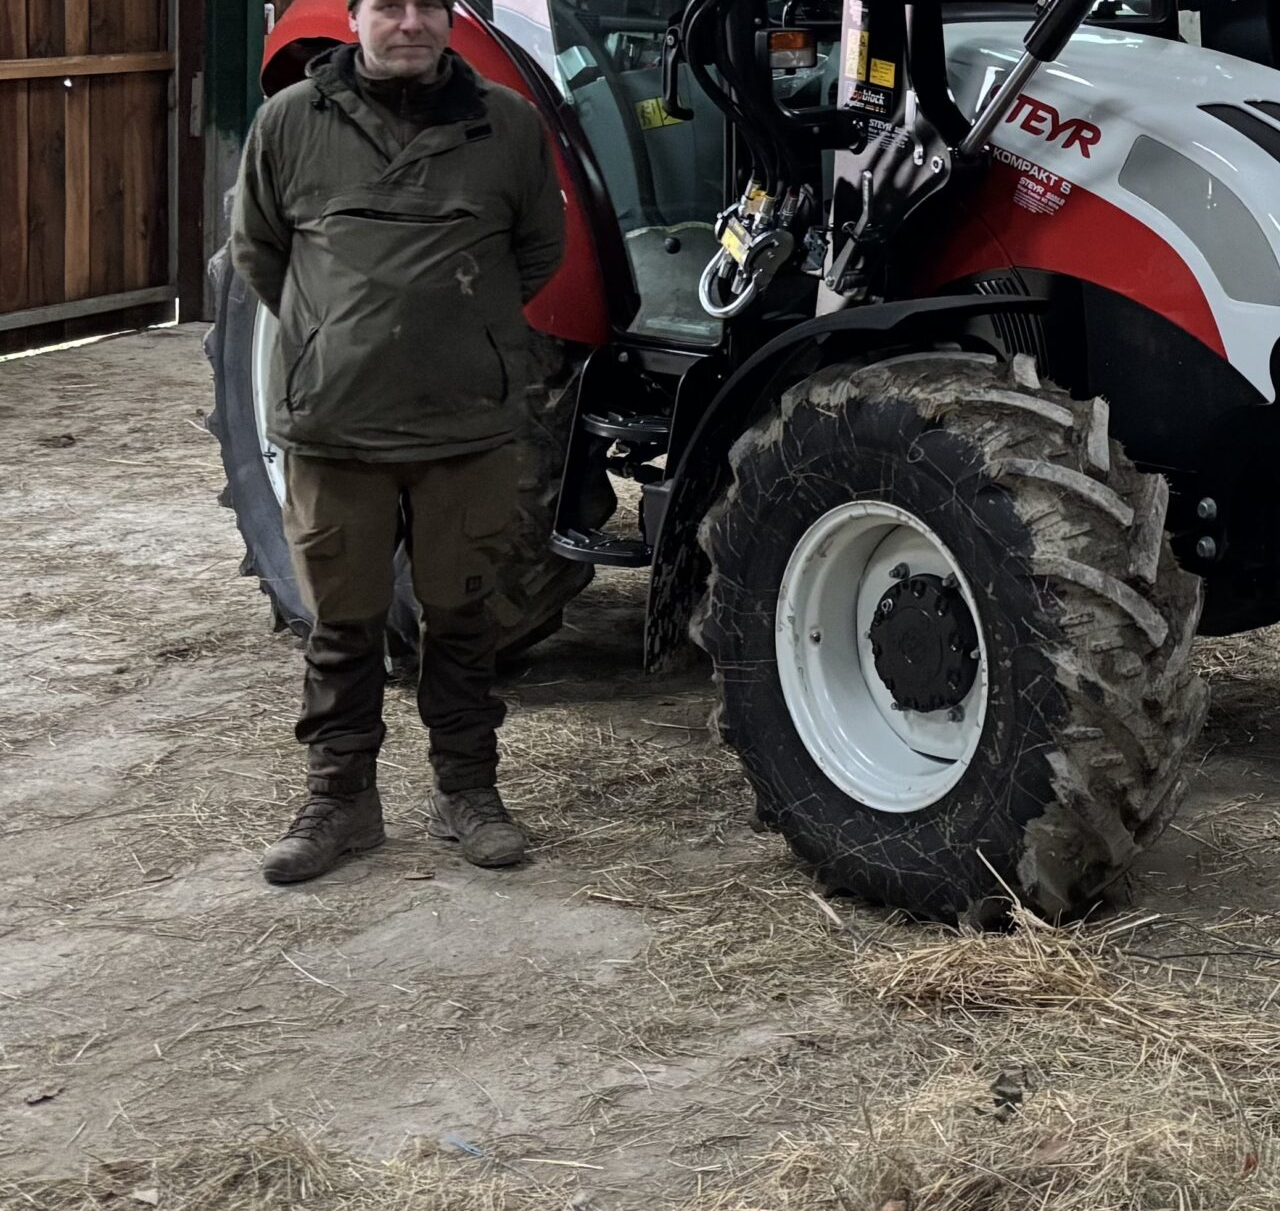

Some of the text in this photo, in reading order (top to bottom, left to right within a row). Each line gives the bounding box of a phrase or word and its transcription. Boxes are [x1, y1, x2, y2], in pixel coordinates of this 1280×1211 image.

[990, 85, 1102, 159] TEYR
[993, 148, 1072, 196] KOMPAKT S
[1019, 176, 1045, 194] STEYR
